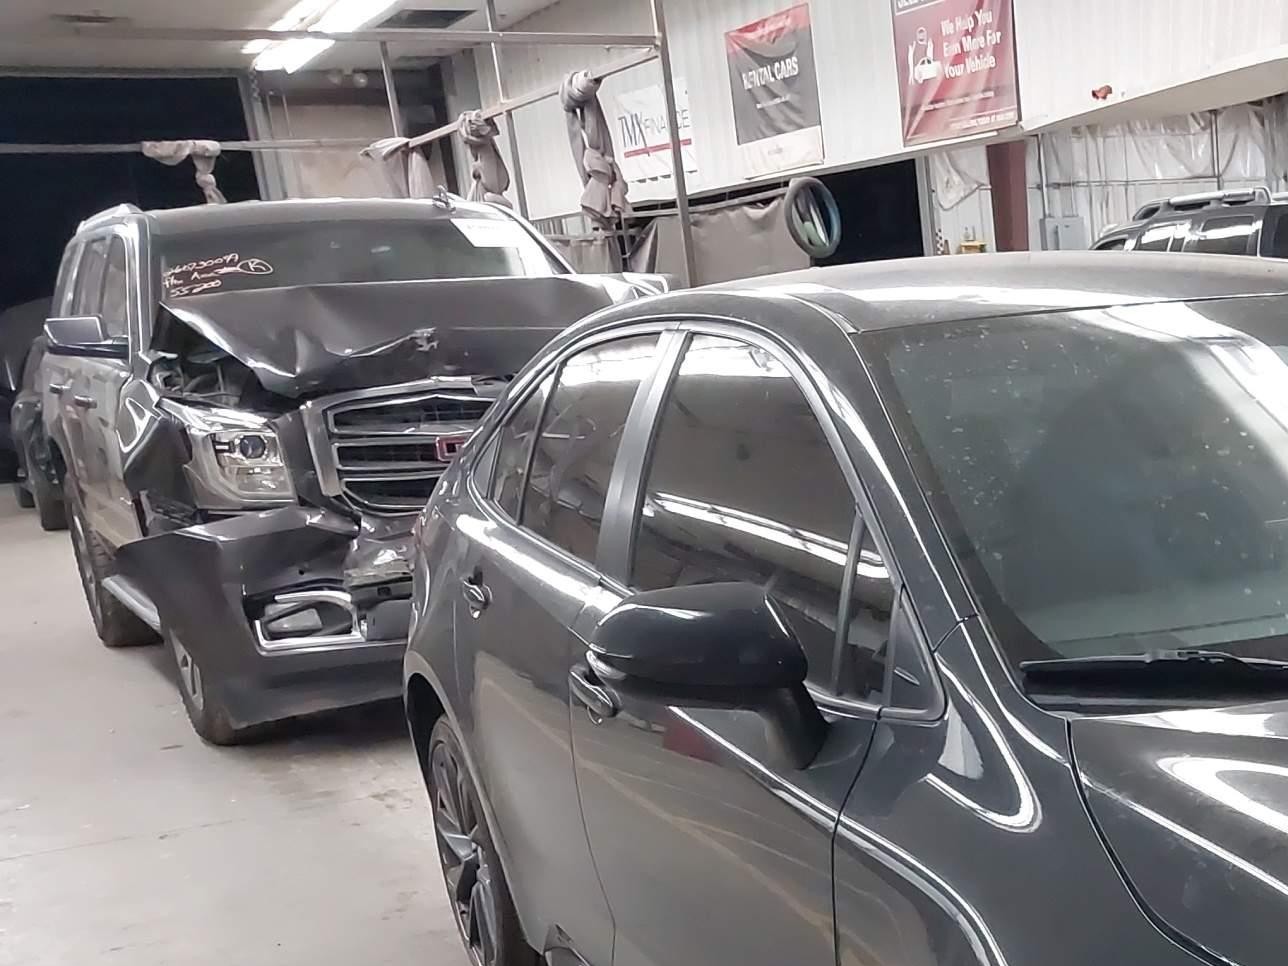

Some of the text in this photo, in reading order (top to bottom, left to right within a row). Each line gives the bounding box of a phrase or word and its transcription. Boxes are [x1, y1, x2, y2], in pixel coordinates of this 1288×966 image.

[975, 9, 993, 26] You
[962, 35, 985, 54] More
[986, 30, 1001, 46] For
[774, 56, 799, 82] CARS
[944, 54, 996, 80] Your Vehicle
